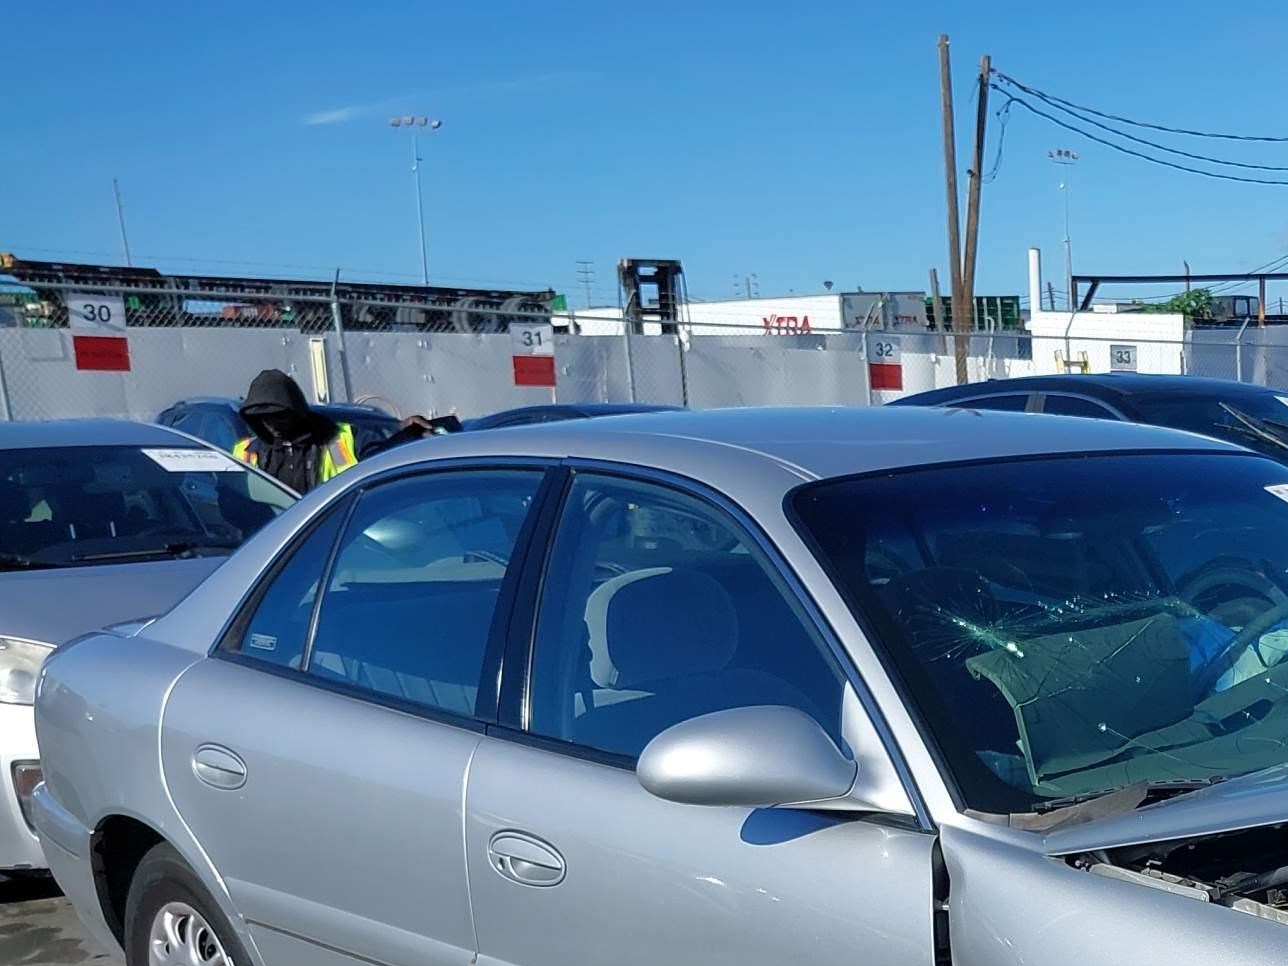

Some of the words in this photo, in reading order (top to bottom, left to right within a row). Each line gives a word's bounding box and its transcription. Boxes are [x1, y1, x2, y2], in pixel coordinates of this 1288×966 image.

[83, 304, 111, 322] 30
[763, 314, 811, 336] XTRA
[522, 331, 542, 347] 31
[875, 342, 893, 357] 32
[1116, 350, 1131, 364] 33
